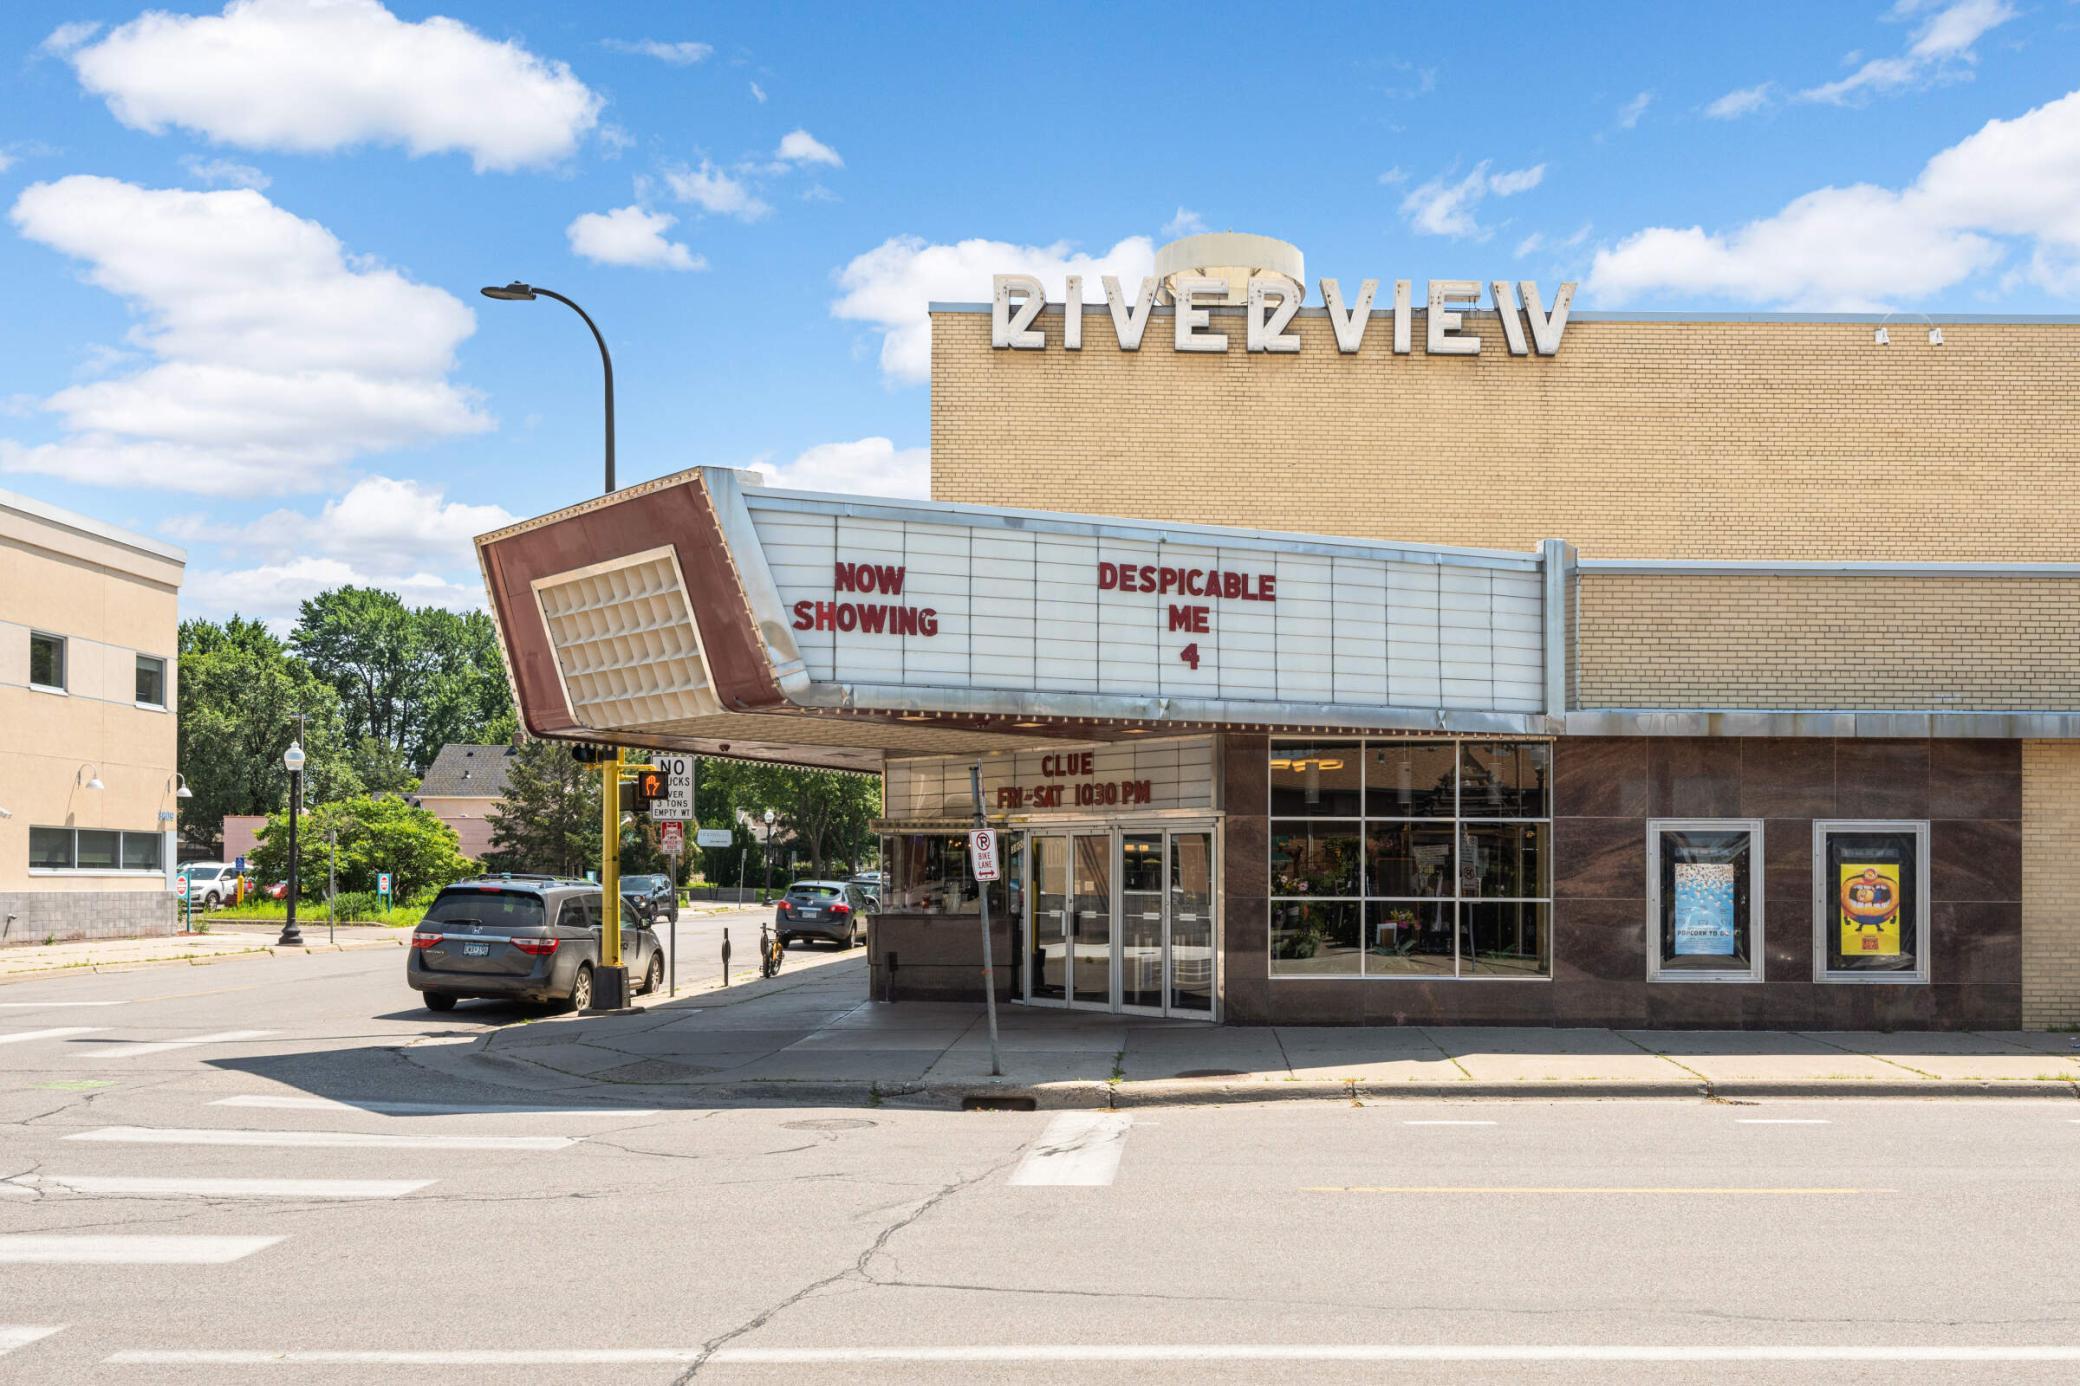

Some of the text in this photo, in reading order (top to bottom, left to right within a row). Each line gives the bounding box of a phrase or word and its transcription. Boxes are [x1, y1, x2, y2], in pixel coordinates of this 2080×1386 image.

[991, 273, 1578, 356] RIVERVIEW
[835, 562, 906, 595] NOW
[1099, 562, 1276, 601] DESPICABLE
[793, 600, 938, 637] SHOWING
[1169, 604, 1210, 633] ME
[1180, 643, 1199, 670] 4
[661, 760, 684, 775] NO
[1041, 752, 1093, 778] CLUE
[1075, 782, 1117, 806] 1030
[1122, 780, 1151, 804] PM
[977, 852, 991, 860] BIKE
